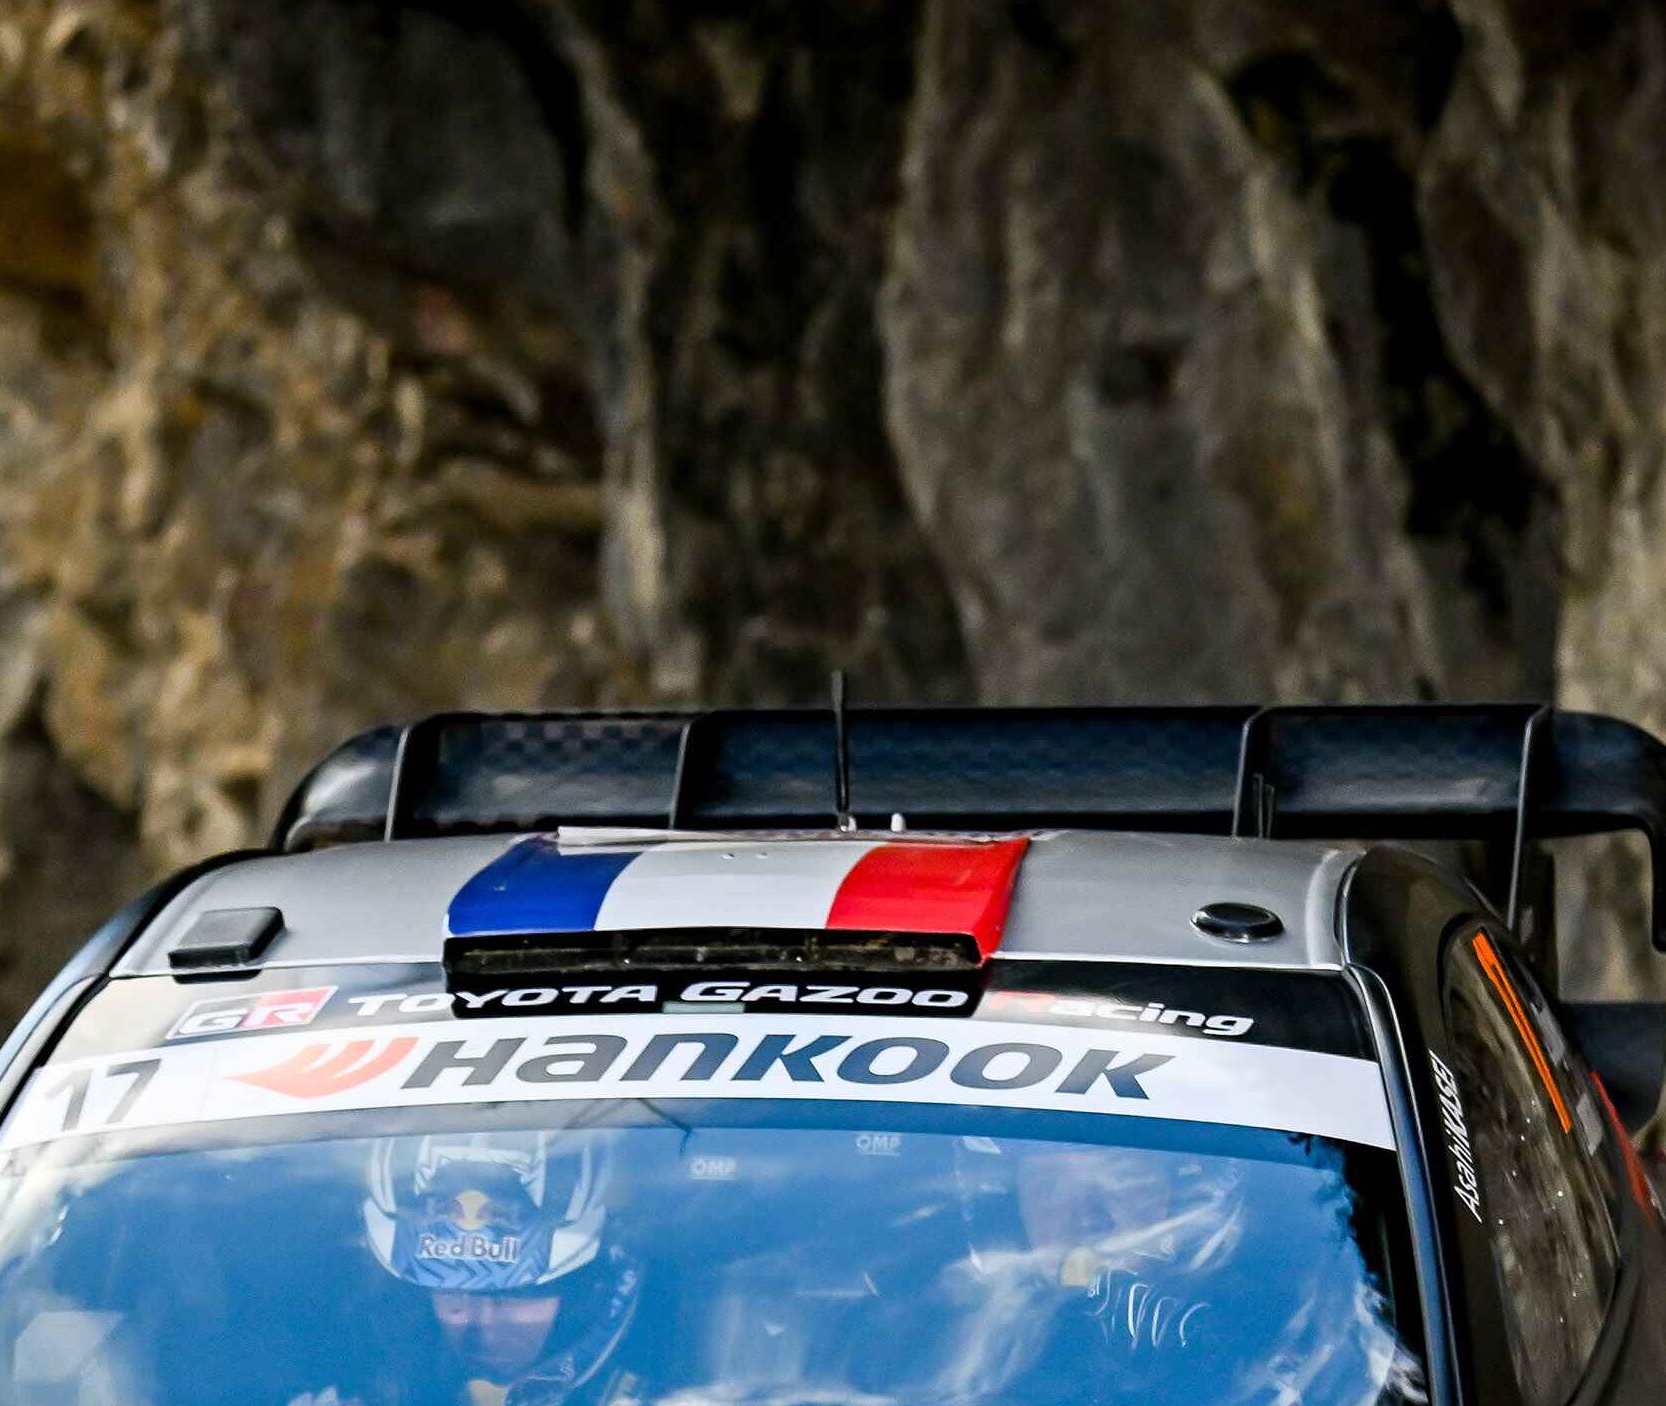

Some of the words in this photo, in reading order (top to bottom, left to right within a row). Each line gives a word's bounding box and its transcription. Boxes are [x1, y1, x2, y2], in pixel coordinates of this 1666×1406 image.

[178, 1001, 304, 1034] GR
[349, 985, 658, 1016] TOYOTA
[680, 982, 968, 1008] GAZOO
[988, 992, 1254, 1035] Racing
[45, 1058, 162, 1132] 17
[420, 1233, 465, 1258] Red
[473, 1234, 518, 1261] Bull
